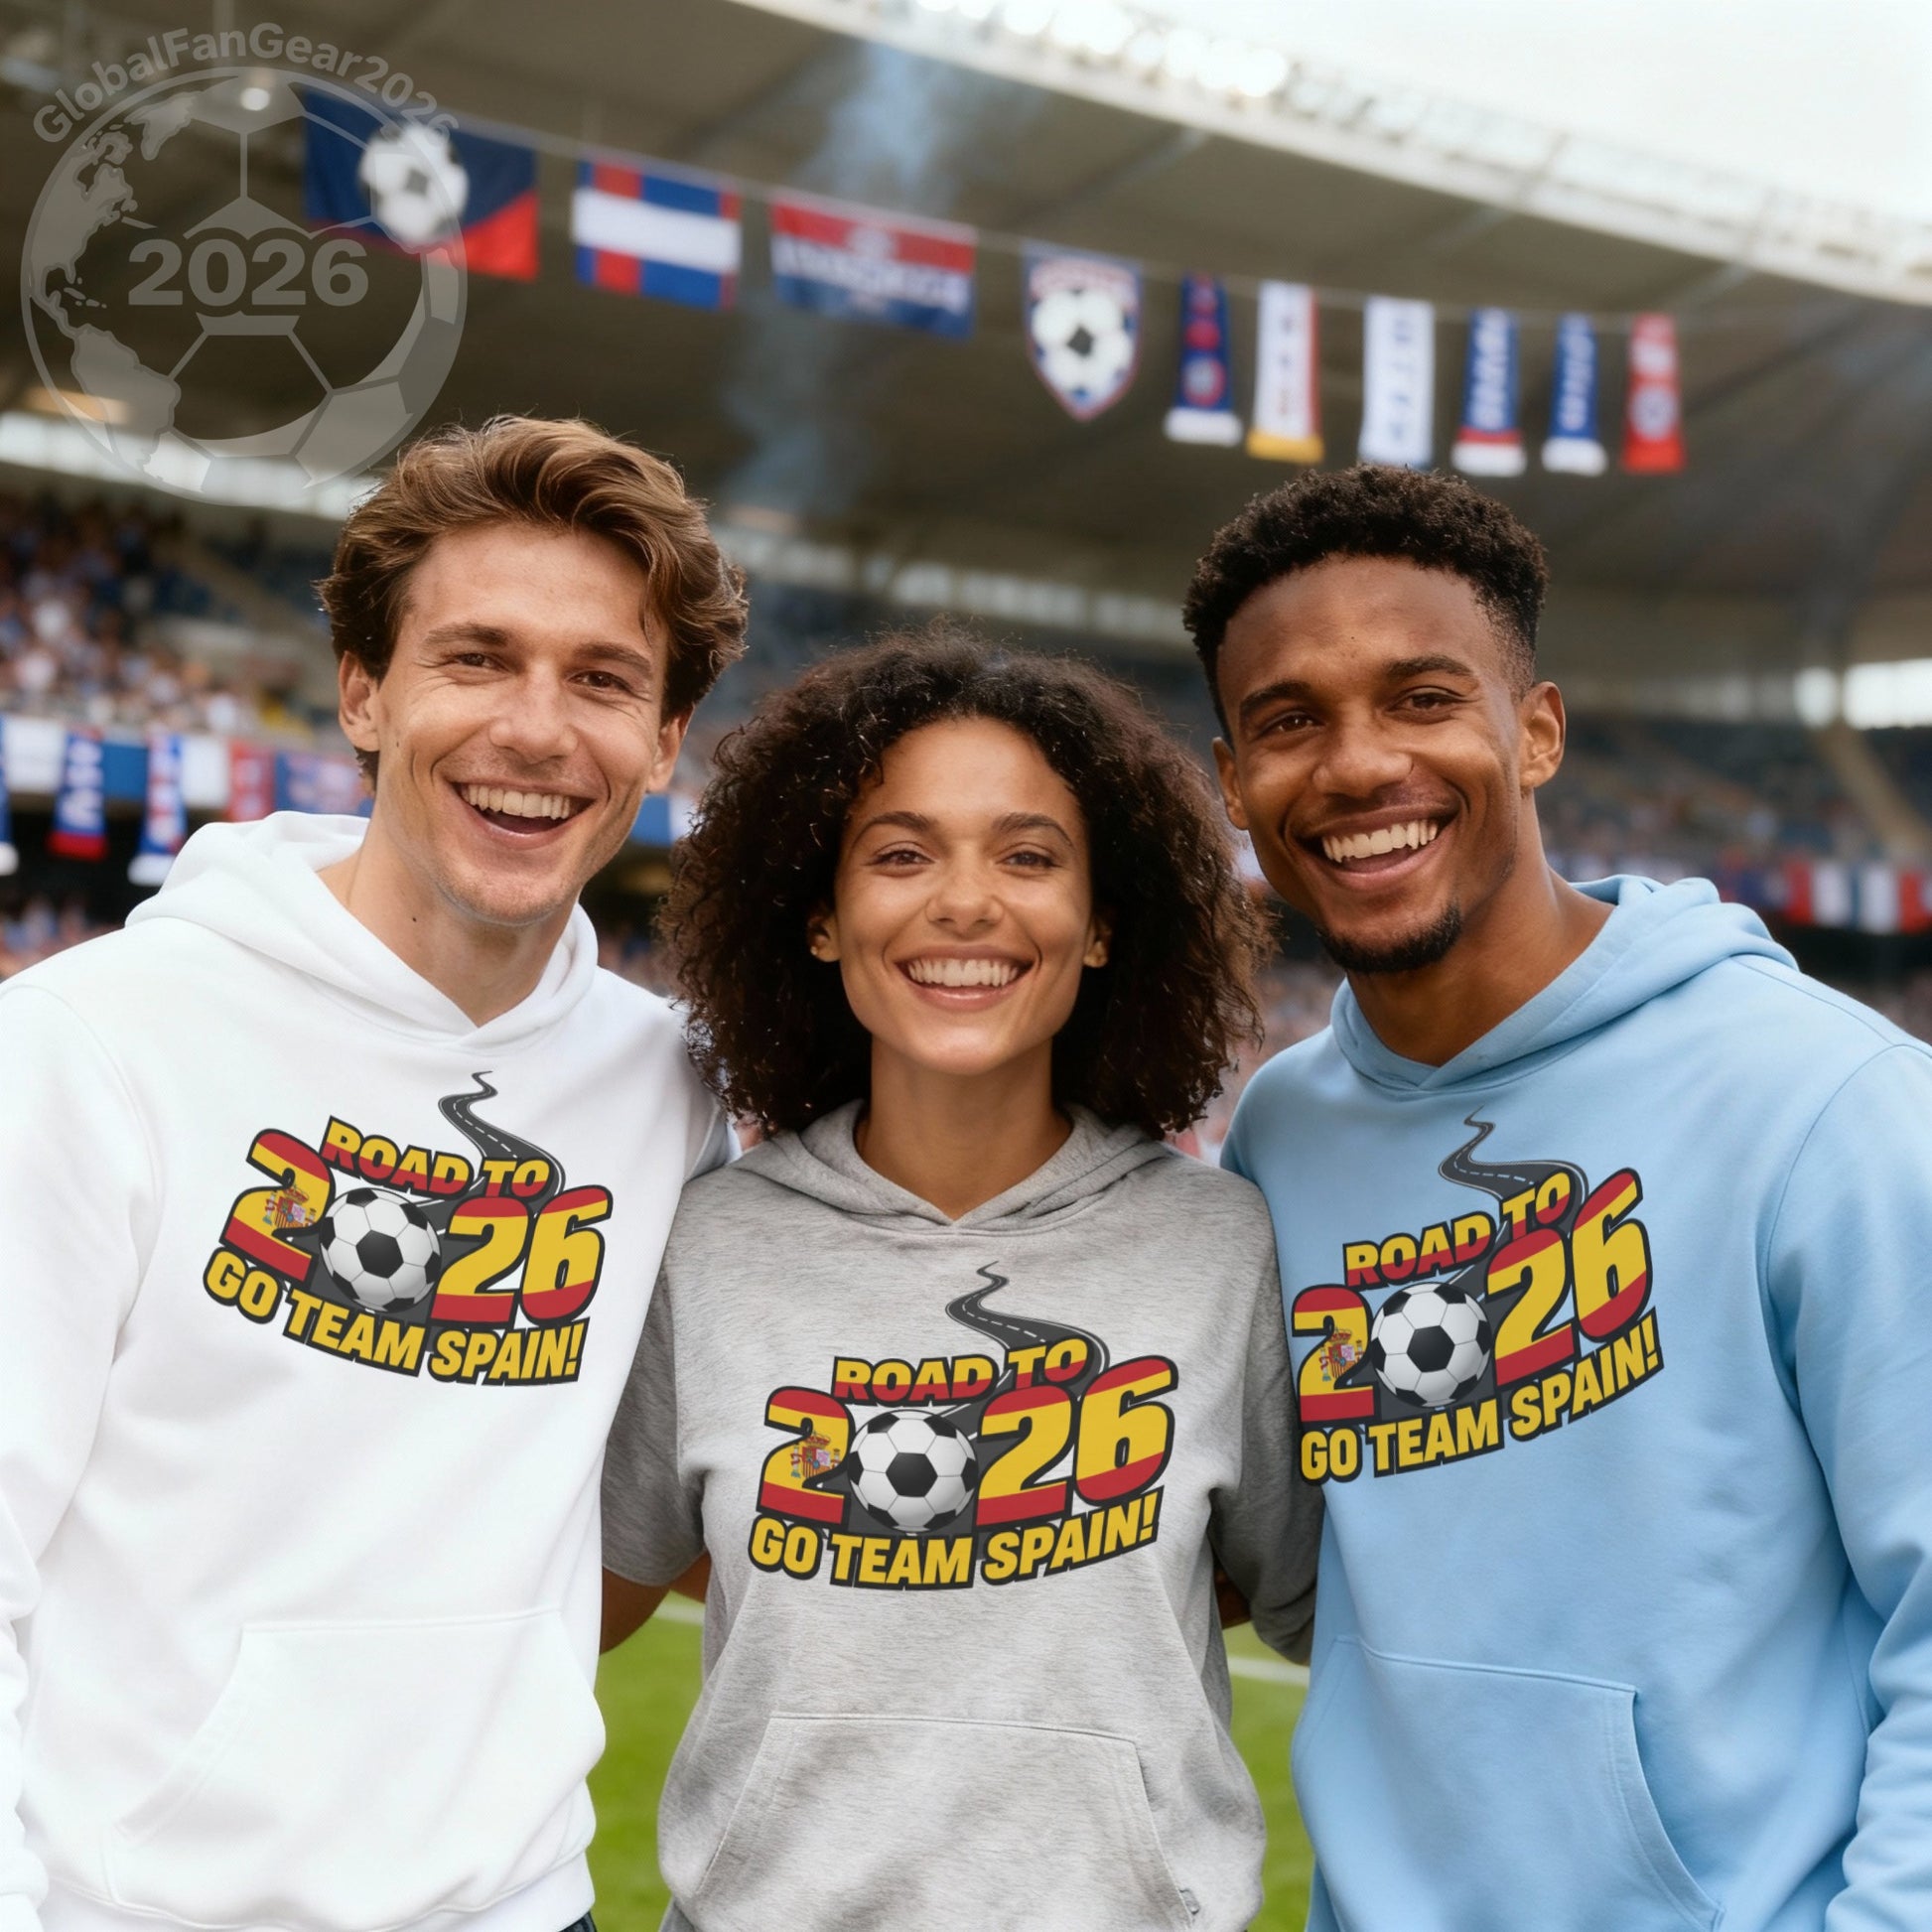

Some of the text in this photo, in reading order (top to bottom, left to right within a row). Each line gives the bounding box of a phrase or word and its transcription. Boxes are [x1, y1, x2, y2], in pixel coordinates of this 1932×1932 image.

[319, 1116, 554, 1199] ROAD TO
[1342, 1171, 1573, 1292] ROAD TO
[203, 1247, 590, 1386] GO TEAM SPAIN!
[832, 1337, 1091, 1407] ROAD TO
[1299, 1307, 1664, 1484] GO TEAM SPAIN!
[748, 1485, 1165, 1590] GO TEAM SPAIN!
